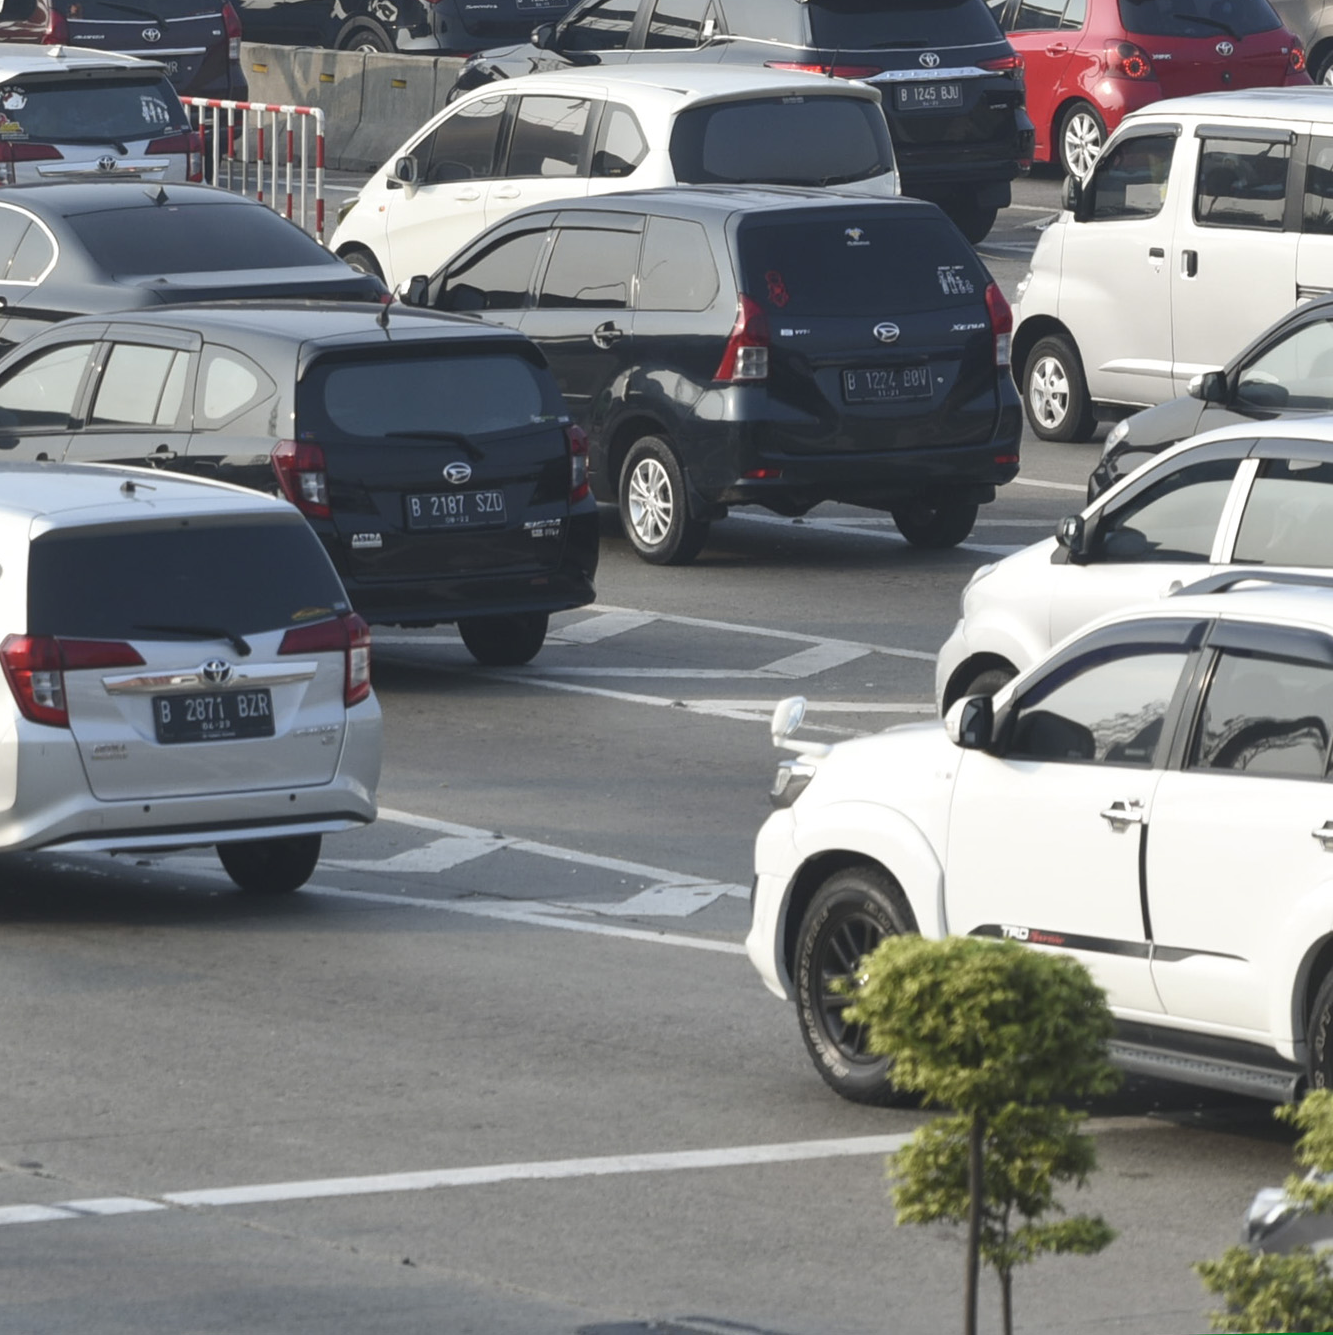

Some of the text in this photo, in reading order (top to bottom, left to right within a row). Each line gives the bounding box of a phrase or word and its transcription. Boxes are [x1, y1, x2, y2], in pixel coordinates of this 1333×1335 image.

[901, 85, 959, 102] B 1245 BJU
[847, 374, 856, 391] B
[411, 493, 503, 517] B 2187 SZD
[352, 532, 382, 544] ASTRA
[160, 694, 270, 724] B 2871 BZR
[1000, 923, 1029, 942] TRD
